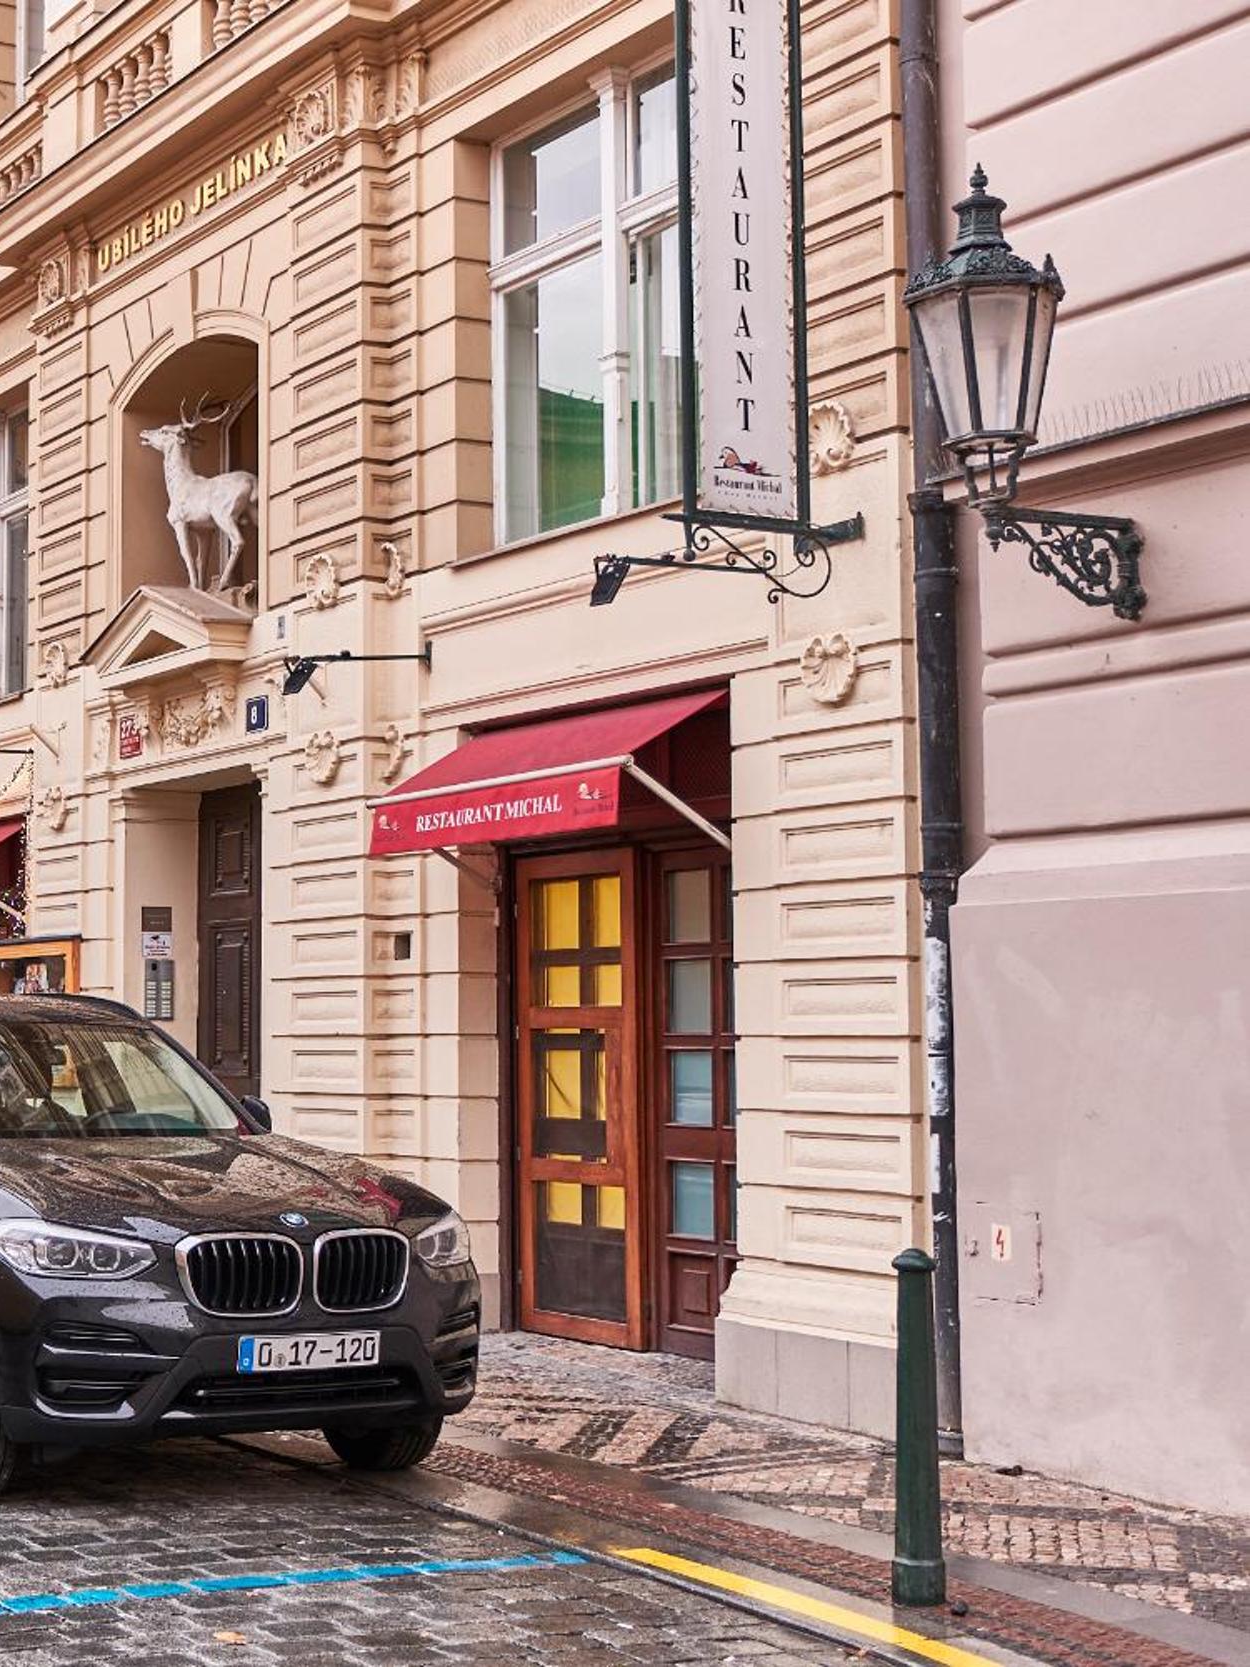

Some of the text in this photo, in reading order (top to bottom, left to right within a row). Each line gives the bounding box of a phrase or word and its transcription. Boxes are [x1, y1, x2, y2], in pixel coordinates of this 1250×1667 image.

[189, 133, 288, 216] JELÍNKA
[251, 706, 257, 724] 8
[415, 804, 504, 833] RESTAURANT
[504, 793, 562, 819] MICHAL
[288, 1337, 376, 1367] 17-120
